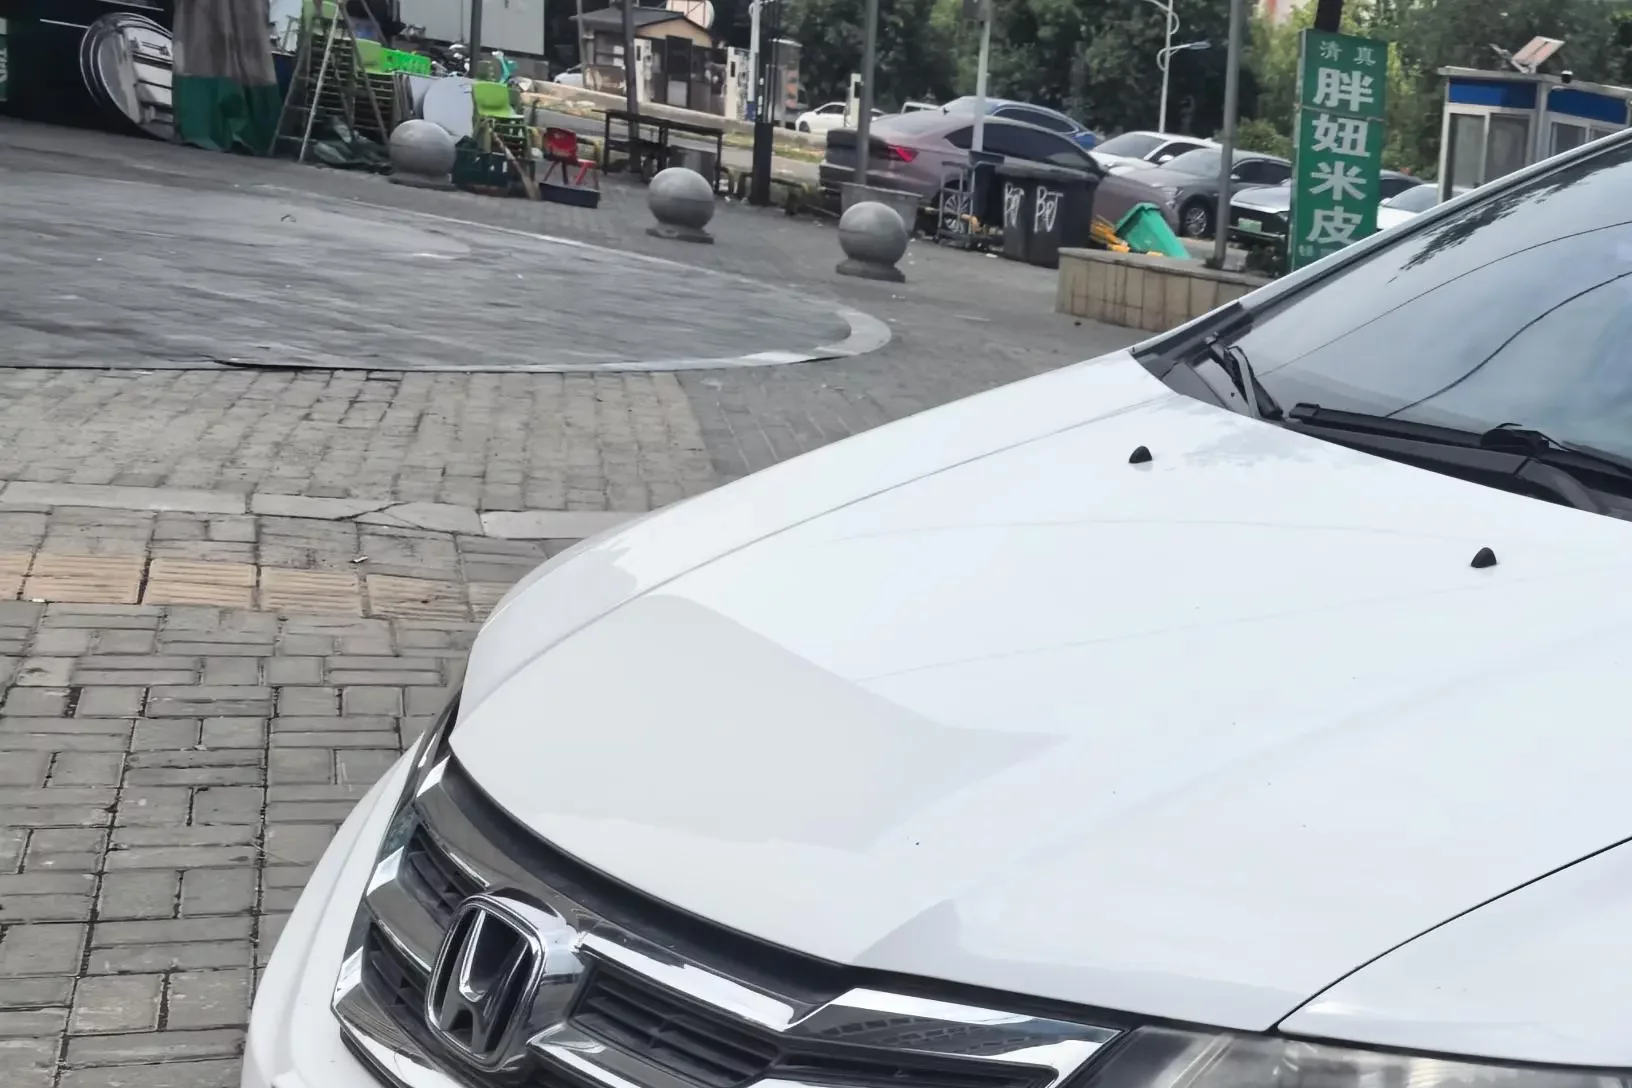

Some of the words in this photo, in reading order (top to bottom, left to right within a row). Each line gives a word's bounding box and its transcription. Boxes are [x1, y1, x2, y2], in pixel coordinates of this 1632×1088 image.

[1320, 41, 1376, 67] 清真
[1306, 67, 1374, 244] 胖妞米皮
